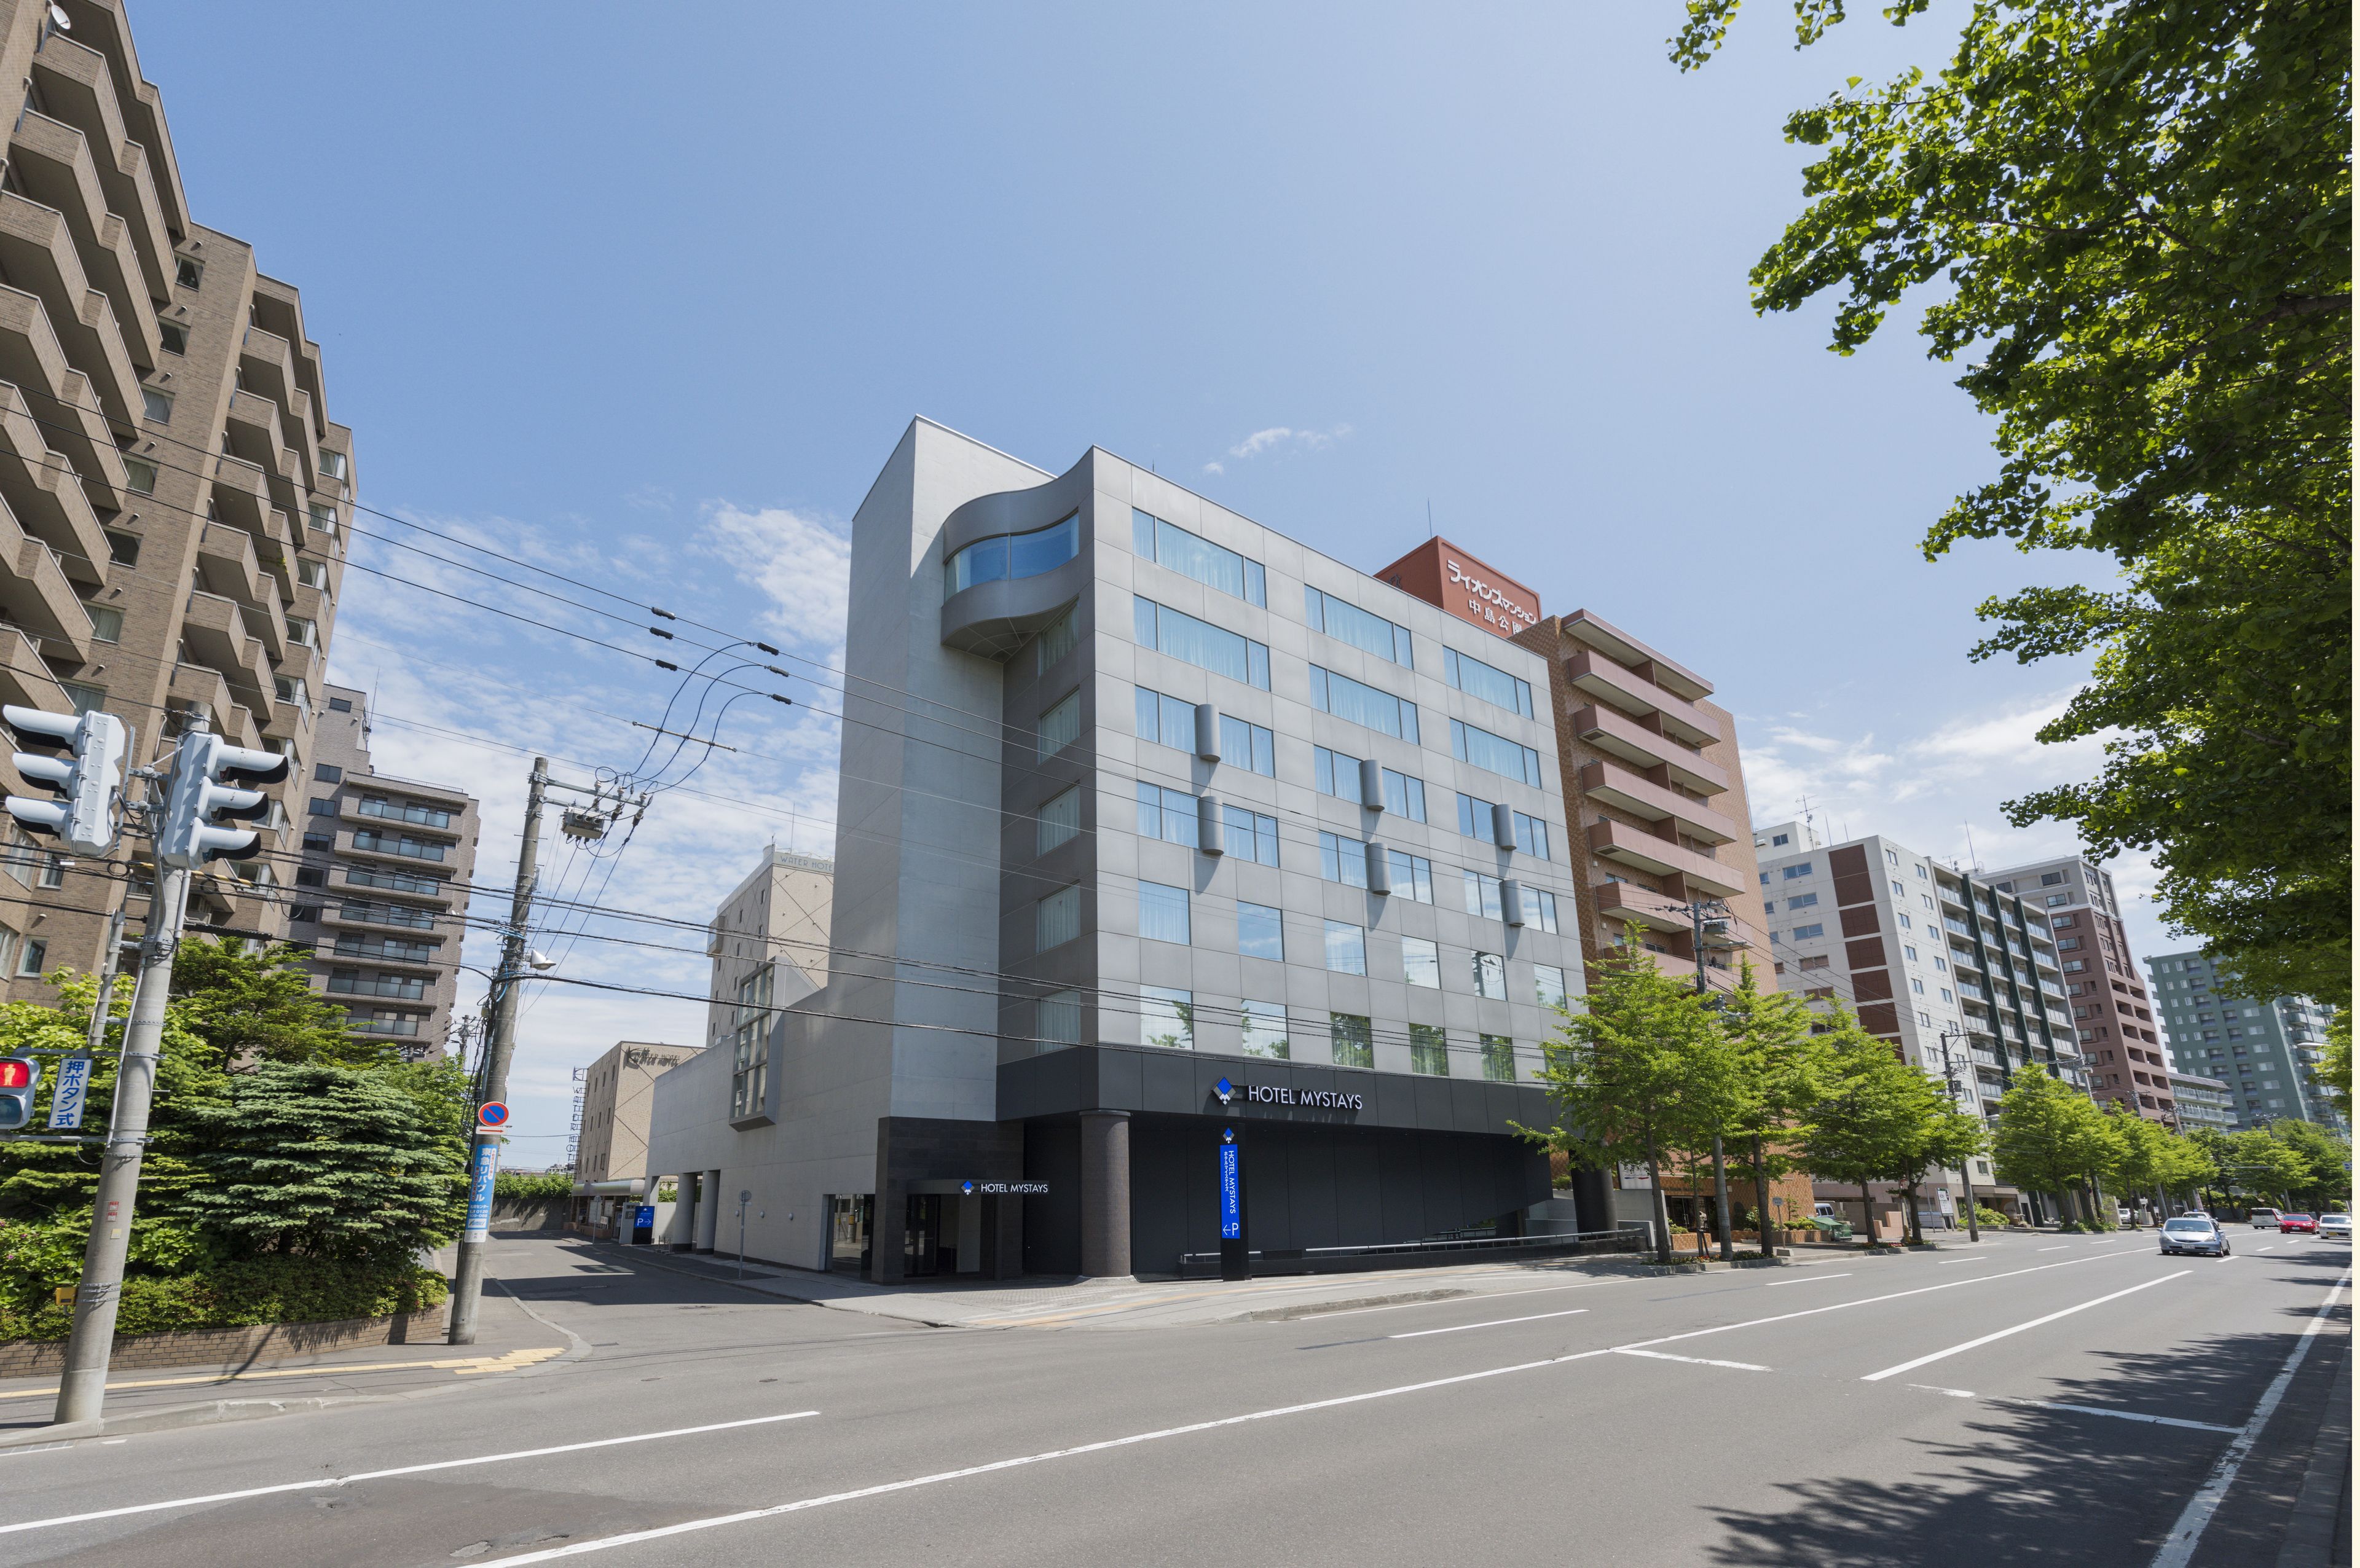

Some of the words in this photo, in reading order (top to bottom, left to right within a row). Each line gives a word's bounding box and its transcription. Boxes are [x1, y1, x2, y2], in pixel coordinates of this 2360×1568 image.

[1447, 559, 1536, 624] ライオンズマンション
[1468, 599, 1522, 635] 中島公園
[781, 856, 808, 867] WATER
[55, 1060, 85, 1126] 押ボタン式
[1248, 1085, 1296, 1105] HOTEL
[1300, 1091, 1363, 1110] MYSTAYS
[475, 1148, 492, 1202] 東急リバブル
[981, 1183, 1009, 1193] HOTEL
[1010, 1184, 1048, 1193] MYSTAYS
[637, 1218, 643, 1226] P
[1232, 1223, 1239, 1236] P
